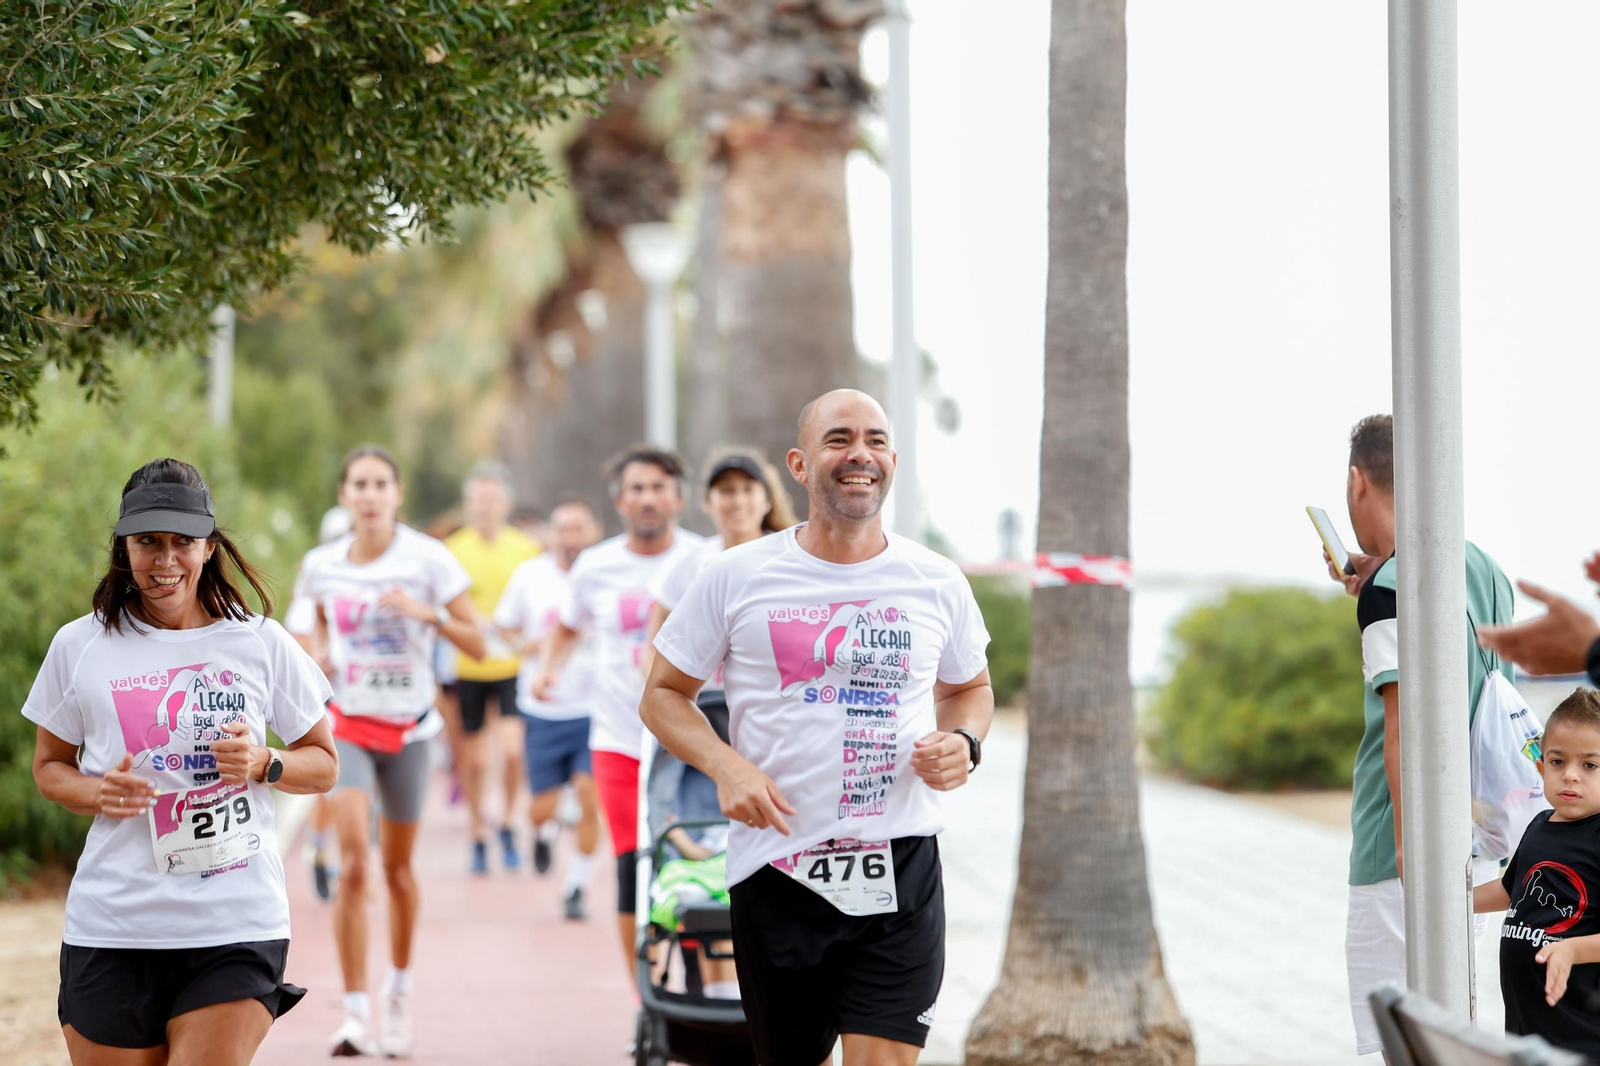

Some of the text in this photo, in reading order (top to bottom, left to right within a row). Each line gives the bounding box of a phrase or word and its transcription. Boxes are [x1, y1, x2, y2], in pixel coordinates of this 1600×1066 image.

[767, 606, 829, 622] valores
[855, 607, 910, 629] AMOR
[110, 674, 168, 690] valores
[193, 670, 242, 693] AMOR
[851, 665, 909, 682] FUERZA
[803, 685, 901, 707] SONRISA
[152, 753, 217, 771] SONR
[843, 748, 897, 768] Deporte
[192, 796, 252, 840] 279
[808, 854, 886, 884] 476
